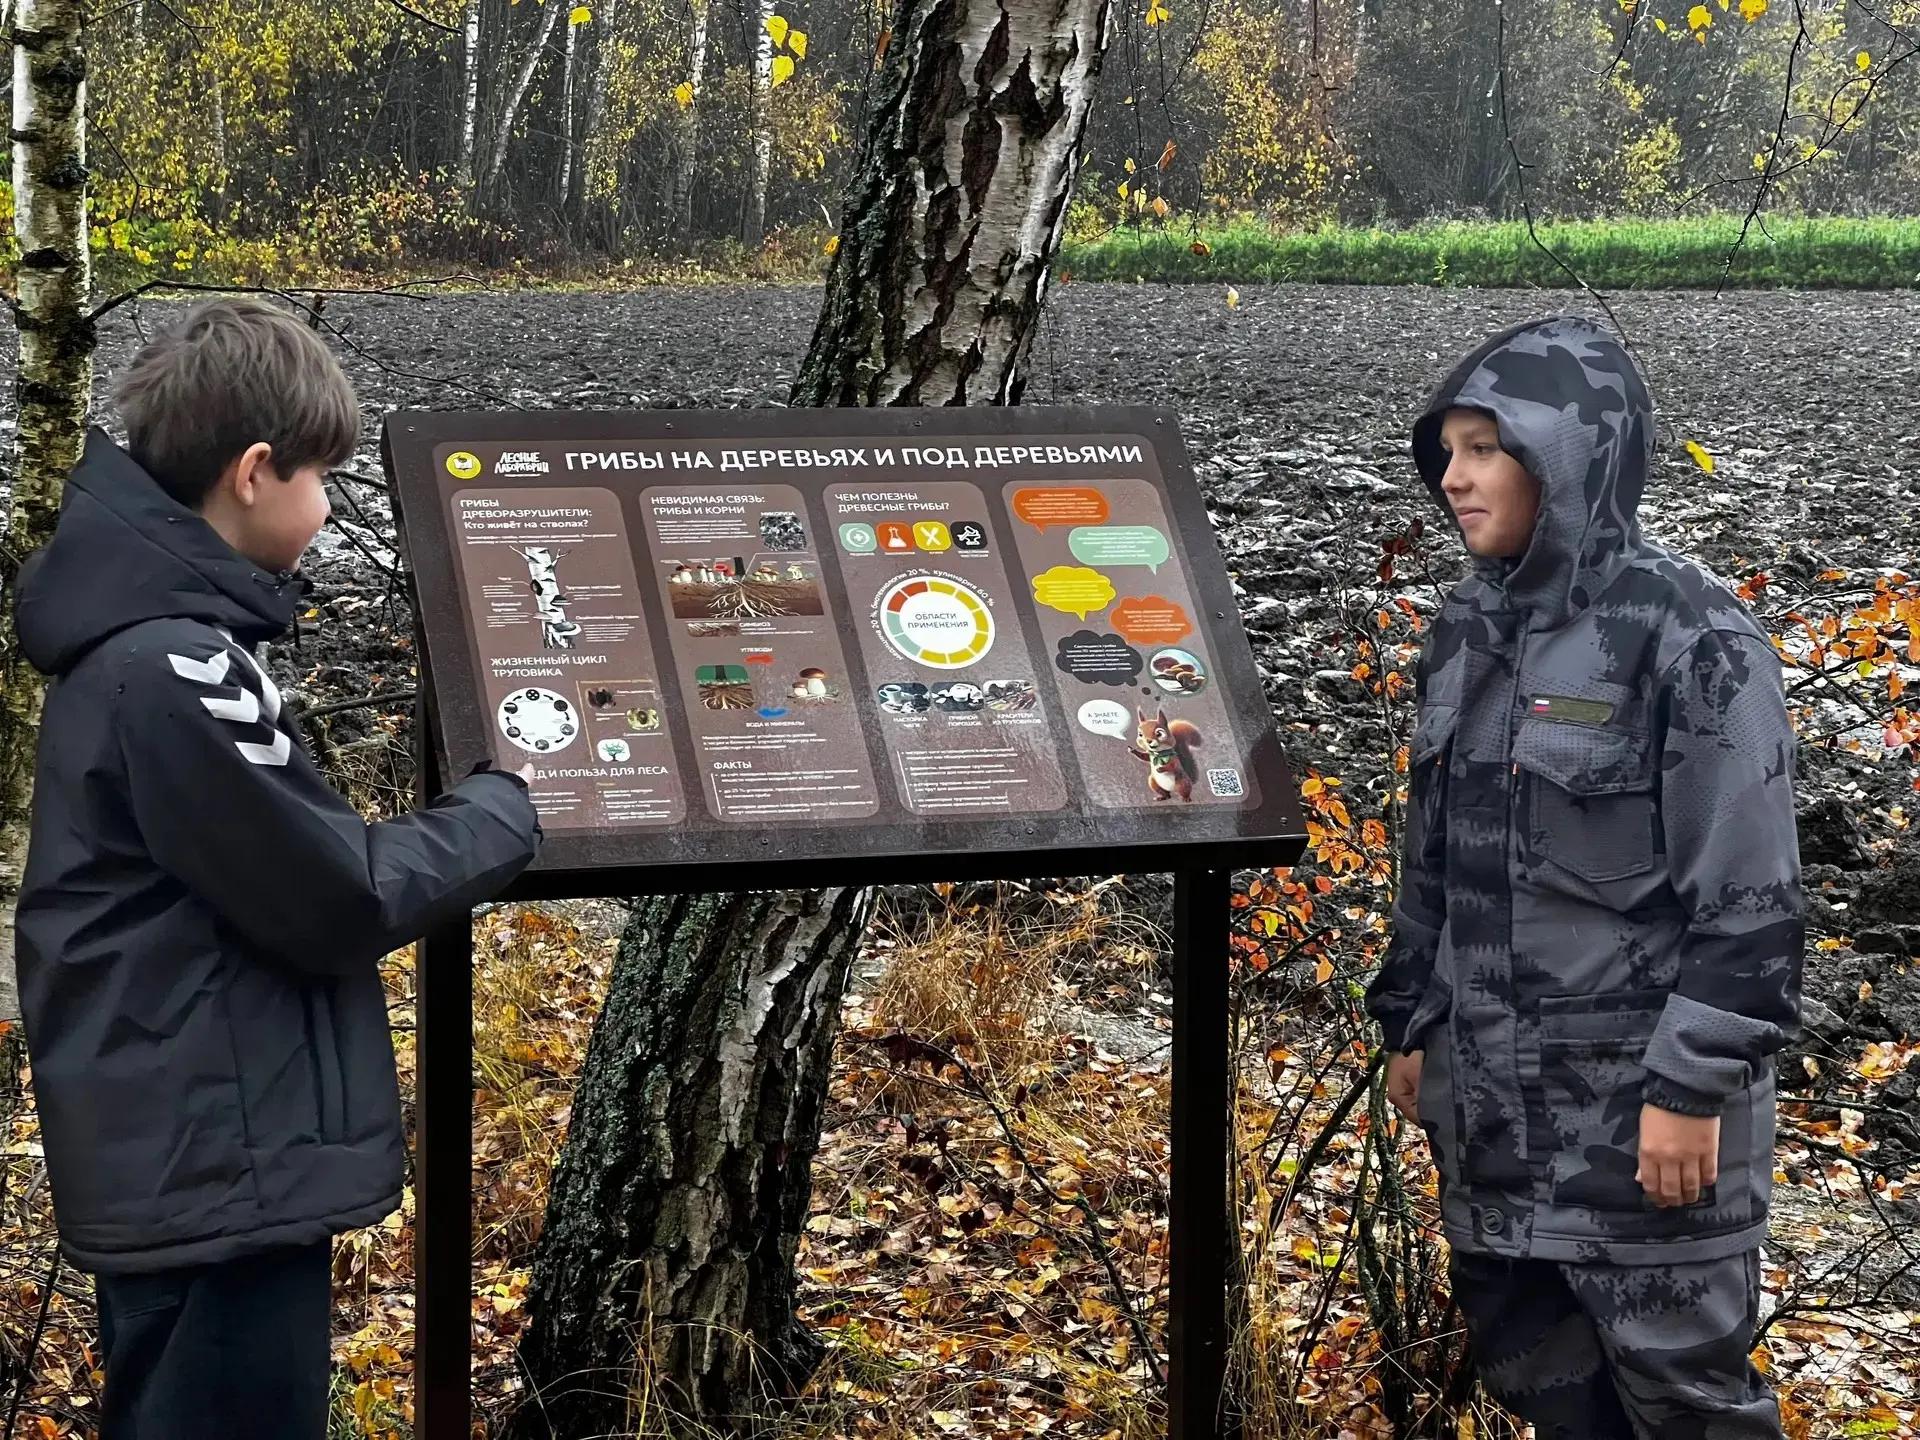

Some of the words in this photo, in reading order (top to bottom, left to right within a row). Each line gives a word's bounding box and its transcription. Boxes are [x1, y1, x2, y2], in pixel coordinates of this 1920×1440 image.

[500, 451, 540, 463] ЛЕСНЫЕ
[565, 451, 663, 471] ГРИБЫ
[671, 450, 713, 469] НА
[720, 448, 867, 471] ДЕРЕВЬЯХ
[874, 448, 895, 466] И
[903, 447, 969, 469] ПОД
[974, 445, 1143, 468] ДЕРЕВЬЯМИ
[651, 496, 724, 506] НЕВИДИМАЯ
[726, 495, 766, 504] СВЯЗЬ:
[835, 493, 860, 501] ЧЕМ
[862, 493, 918, 501] ПОЛЕЗНЫ
[460, 499, 500, 508] ГРИБЫ
[838, 503, 906, 513] ДРЕВЕСНЫЕ
[907, 502, 950, 511] ГРИБЫ?
[462, 508, 592, 520] ДРЕВОРАЗРУШИТЕЛИ:
[653, 507, 692, 516] ГРИБЫ
[694, 507, 703, 515] И
[705, 506, 745, 515] КОРНИ
[464, 521, 485, 529] Кто
[487, 520, 521, 529] живёт
[524, 521, 538, 529] на
[540, 519, 589, 529] стволах?
[915, 612, 957, 620] ОБЛАСТИ
[907, 621, 969, 629] ПРИМЕНЕНИЯ
[491, 654, 570, 667] ЖИЗНЕННЫЙ
[572, 655, 607, 666] ЦИКЛ
[492, 667, 563, 678] ТРУТОВИКА
[713, 761, 752, 769] ФАКТЫ
[549, 768, 558, 778] И
[559, 768, 608, 779] ПОЛЬЗА
[610, 767, 636, 778] ДЛЯ
[638, 765, 669, 776] ЛЕСА
